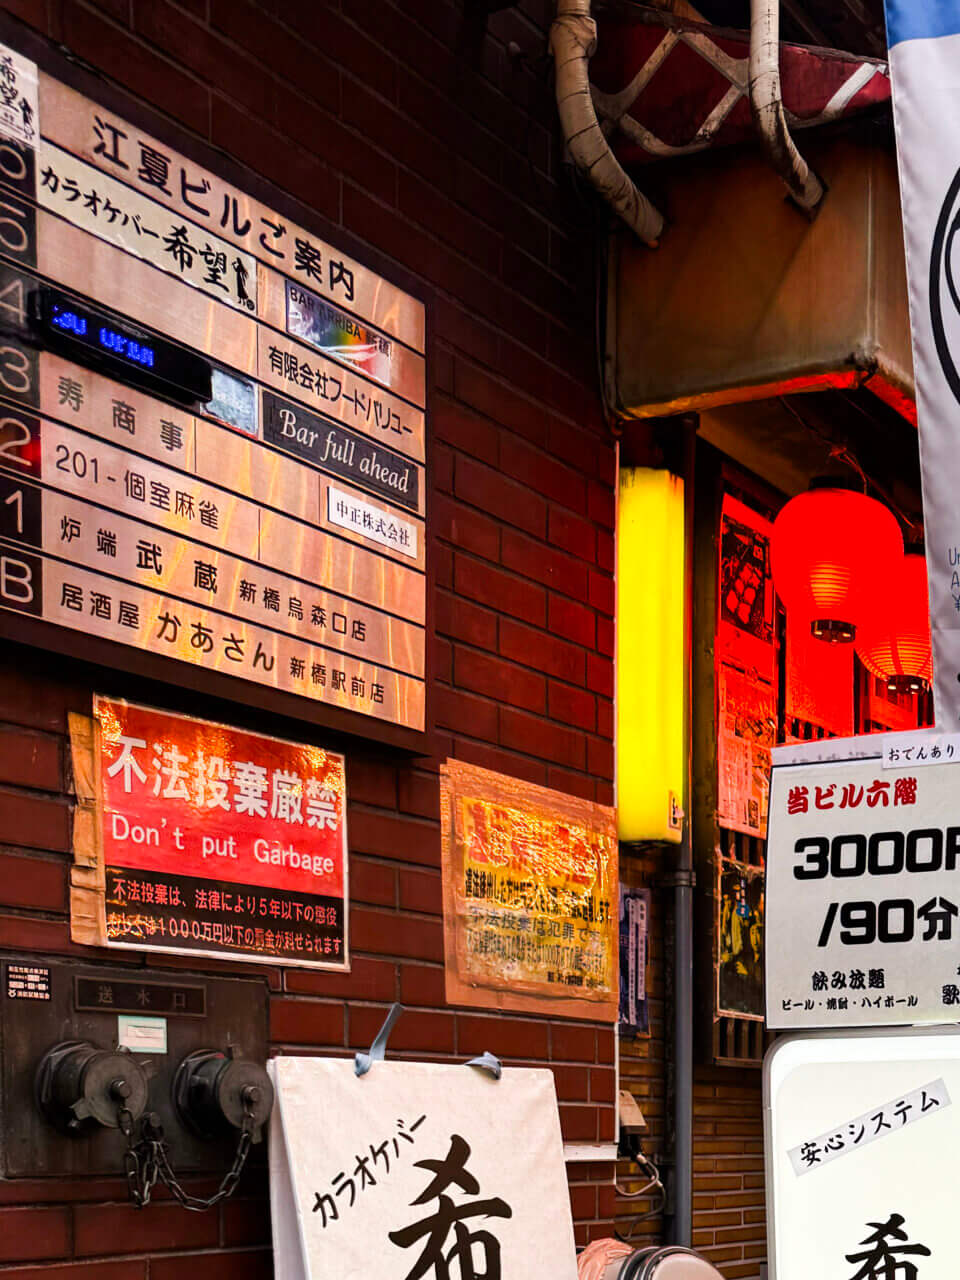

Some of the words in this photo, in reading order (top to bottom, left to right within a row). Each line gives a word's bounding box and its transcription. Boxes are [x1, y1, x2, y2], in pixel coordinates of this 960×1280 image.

[93, 116, 355, 303] 江夏ビルご案内
[269, 346, 412, 435] 有限会社フードバリュー
[0, 417, 32, 467] 2
[279, 408, 318, 448] Bar
[320, 431, 355, 467] full
[359, 452, 409, 494] ahead
[5, 489, 24, 534] 1
[336, 500, 411, 548] 中正株式会社
[1, 555, 34, 604] B
[950, 572, 960, 590] A
[60, 582, 140, 630] 居酒屋
[156, 611, 274, 672] かあさん
[290, 657, 384, 704] 新橋駅前店
[108, 735, 337, 831] 不法投棄厳禁
[787, 777, 918, 815] 当ビル六階
[112, 813, 184, 850] Don't
[202, 835, 237, 859] put
[254, 838, 335, 876] Garbage
[817, 896, 958, 947] /90分
[811, 968, 885, 991] 飲み放題
[800, 1088, 941, 1168] 安心システム
[312, 1114, 427, 1228] カラオケバー
